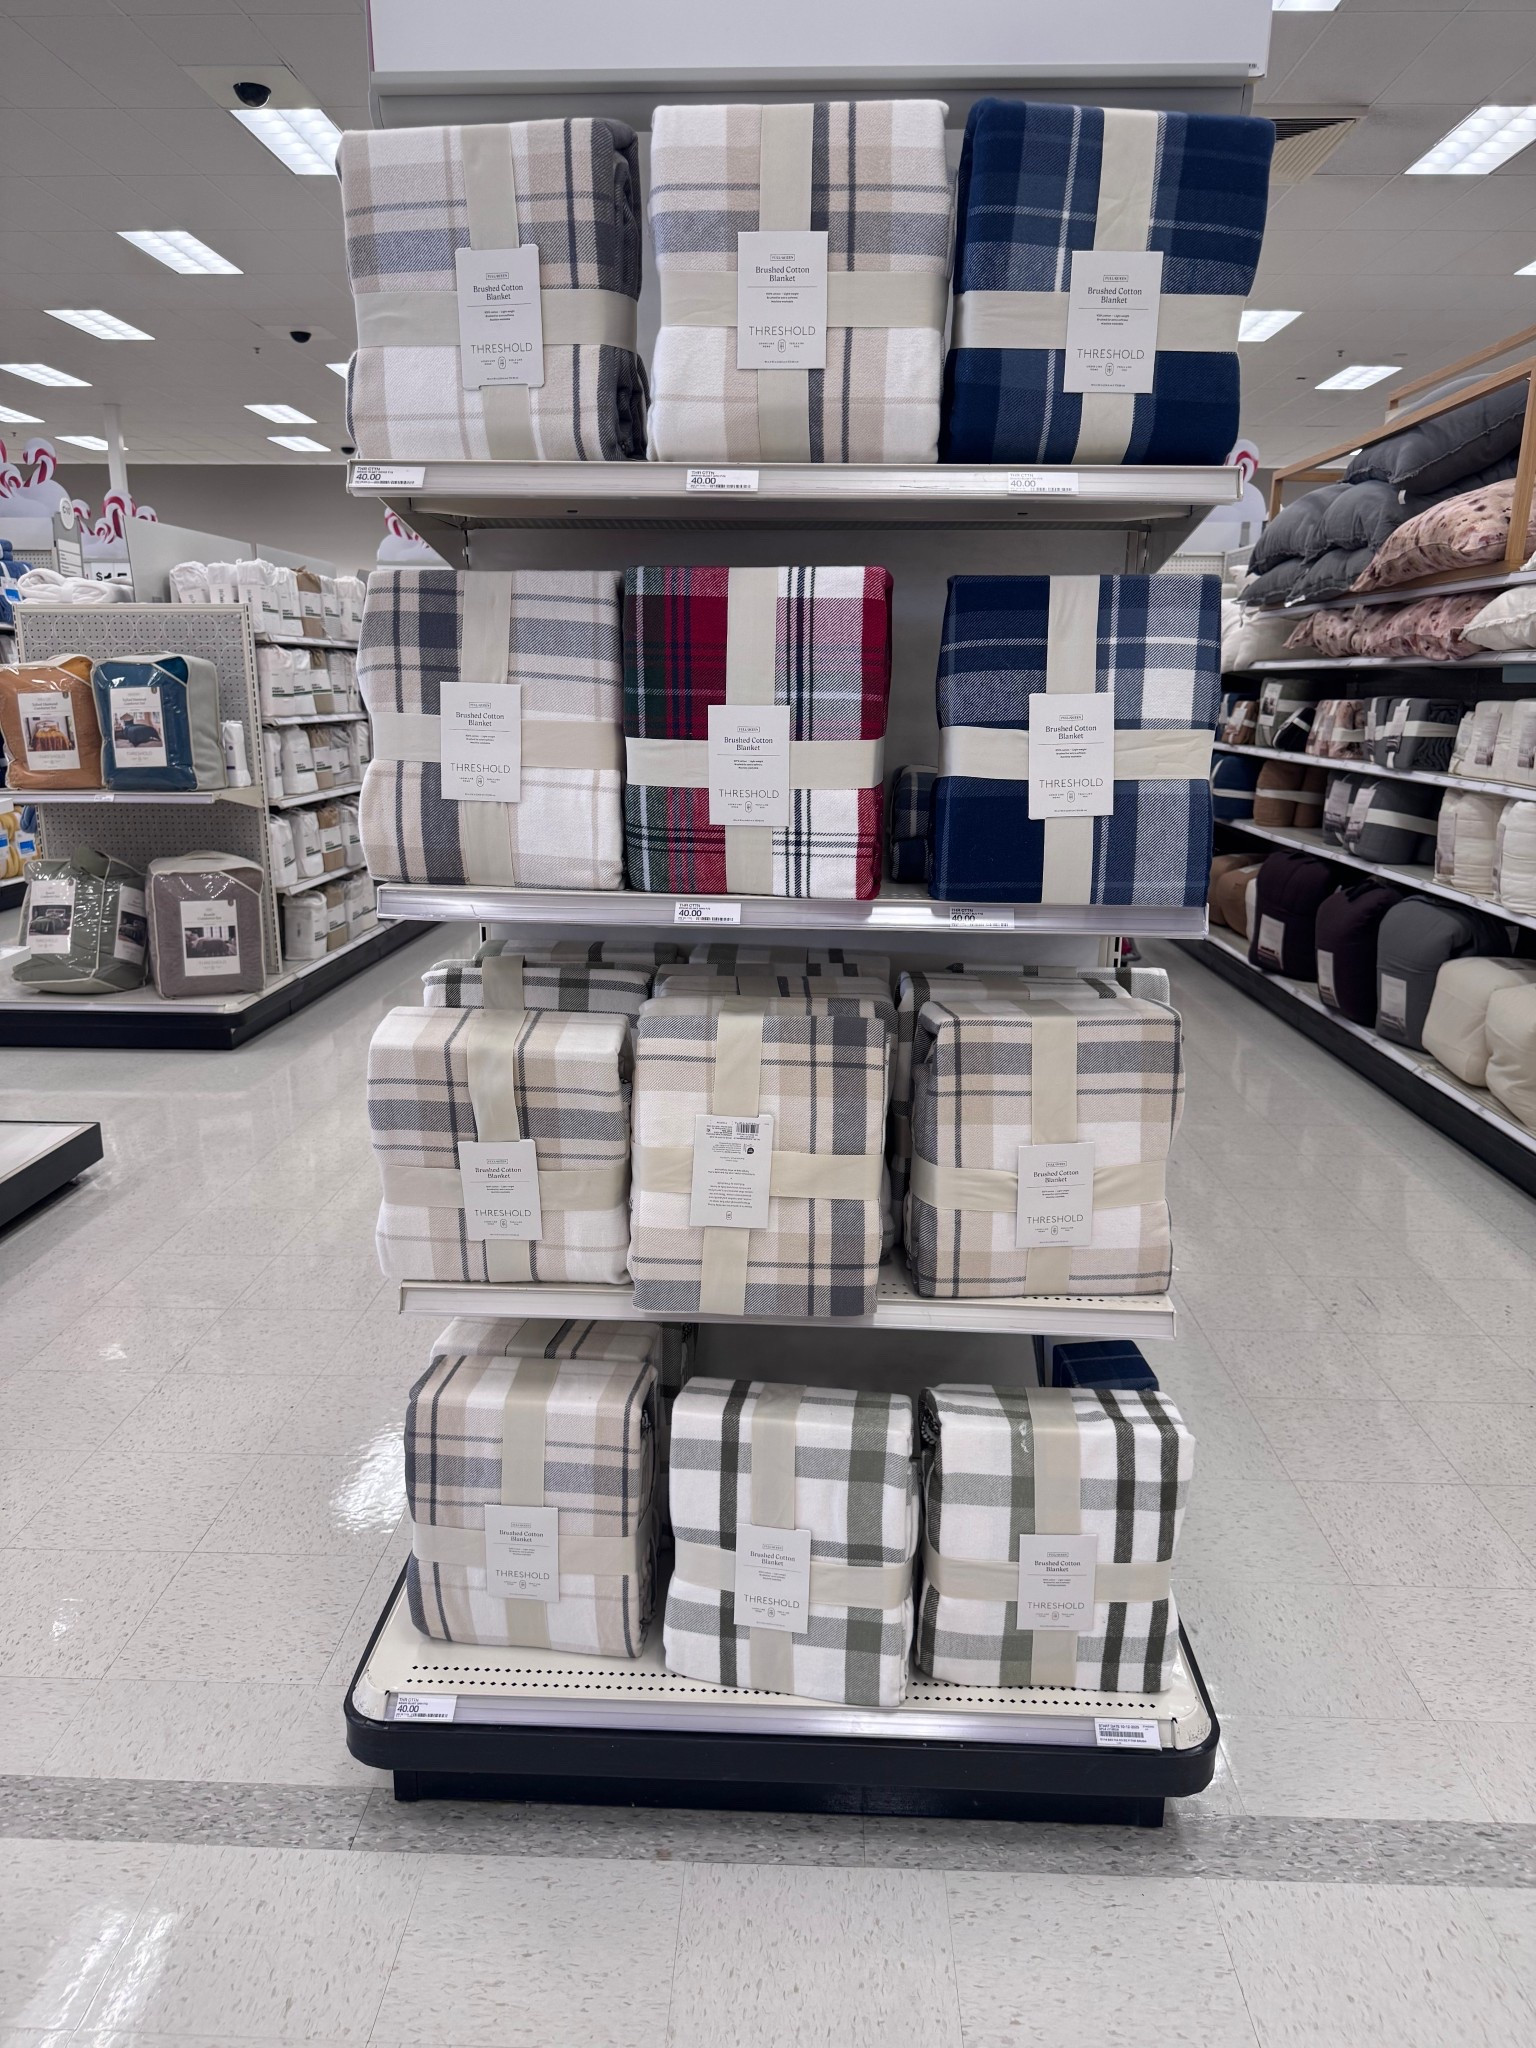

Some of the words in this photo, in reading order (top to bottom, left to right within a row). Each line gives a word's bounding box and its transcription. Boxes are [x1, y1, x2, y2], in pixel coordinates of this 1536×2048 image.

[755, 266, 785, 274] Brushed
[785, 266, 810, 274] Cotton
[769, 274, 796, 282] Blanket
[473, 284, 500, 293] Brushed
[501, 284, 524, 292] Cotton
[1087, 286, 1117, 295] Brushed
[1118, 287, 1142, 296] Cotton
[486, 293, 511, 301] Blanket
[1100, 296, 1128, 304] Blanket
[748, 325, 816, 336] THRESHOLD
[470, 342, 533, 354] THRESHOLD
[1077, 348, 1145, 360] THRESHOLD
[356, 473, 381, 481] 40.00
[691, 477, 717, 485] 40.00
[455, 711, 482, 719] Brushed
[483, 712, 505, 720] Cotton
[468, 719, 492, 727] Blanket
[1045, 725, 1073, 733] Brushed
[1074, 724, 1097, 732] Cotton
[724, 736, 751, 744] Brushed
[1058, 732, 1084, 740] Blanket
[450, 762, 511, 774] THRESHOLD
[1038, 777, 1104, 789] THRESHOLD
[718, 788, 780, 799] THRESHOLD
[678, 909, 702, 917] 40.00
[951, 914, 976, 922] 40.00
[474, 1209, 532, 1217] THRESHOLD
[1026, 1214, 1084, 1224] THRESHOLD
[750, 1550, 775, 1559] Brushed
[775, 1554, 796, 1562] Cotton
[761, 1558, 784, 1566] Blanket
[495, 1569, 550, 1580] THRESHOLD
[743, 1593, 800, 1609] THRESHOLD
[1027, 1601, 1085, 1610] THRESHOLD
[397, 1704, 420, 1713] 40.00
